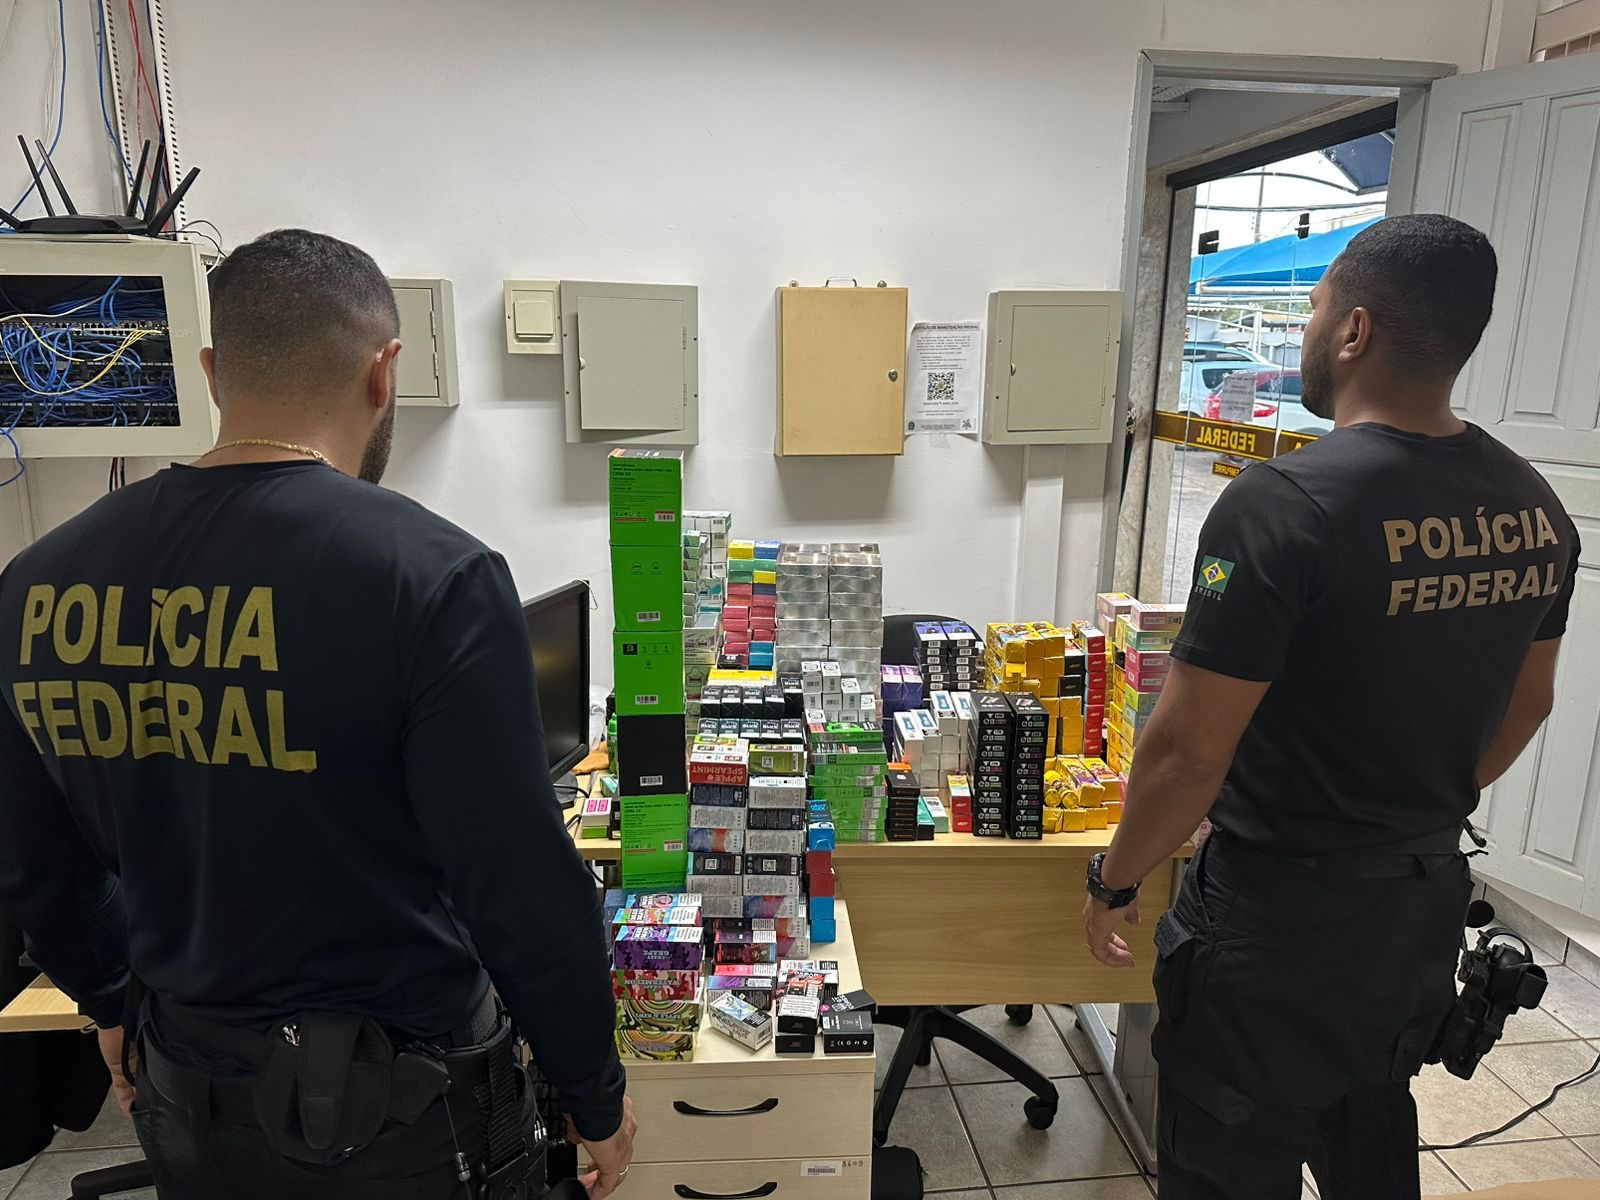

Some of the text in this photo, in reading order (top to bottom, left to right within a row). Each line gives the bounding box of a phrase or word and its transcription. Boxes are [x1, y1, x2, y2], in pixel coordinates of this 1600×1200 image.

[1383, 506, 1559, 562] POLÍCIA
[1386, 563, 1558, 616] FEDERAL
[20, 583, 279, 672] POLÍCIA
[13, 680, 317, 773] FEDERAL
[692, 766, 744, 774] SPEARMINT
[716, 773, 744, 782] APPLE
